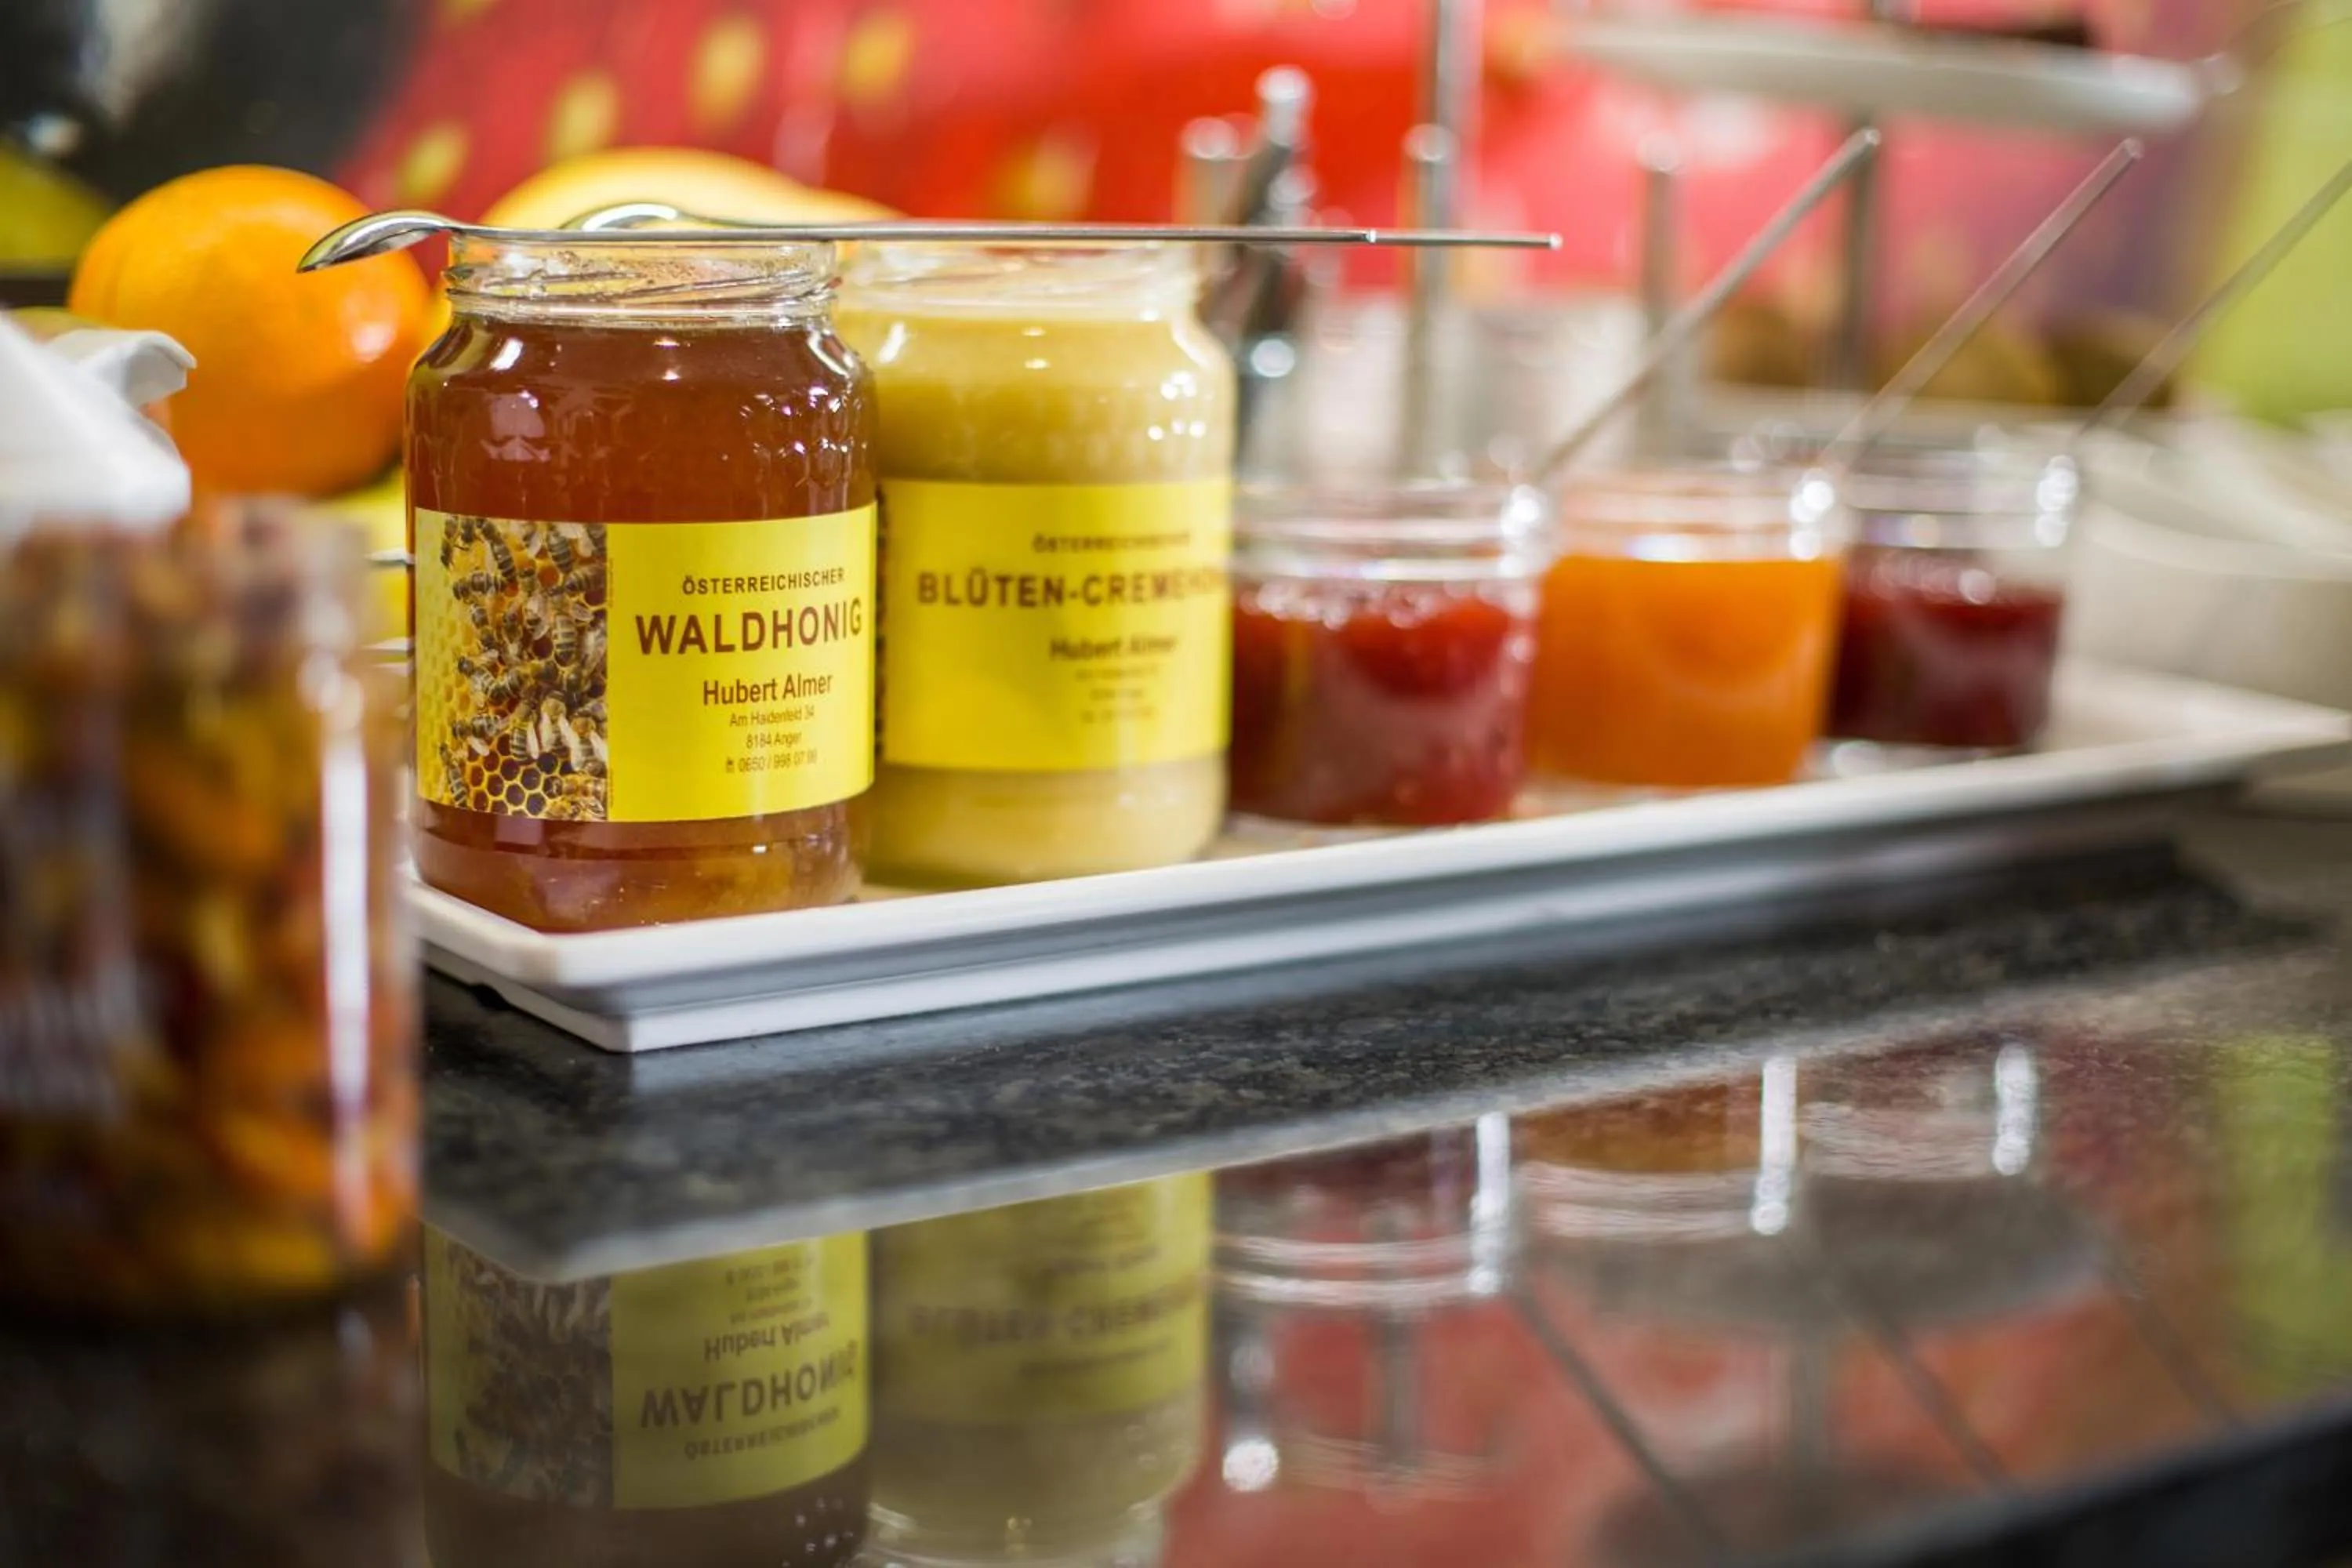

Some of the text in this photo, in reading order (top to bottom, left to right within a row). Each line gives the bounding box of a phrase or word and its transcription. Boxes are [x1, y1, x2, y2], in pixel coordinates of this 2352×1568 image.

[682, 568, 844, 594] ÖSTERREICHISCHER
[635, 597, 862, 655] WALDHONIG
[703, 673, 833, 705] Hubert Almer
[729, 713, 748, 727] Am
